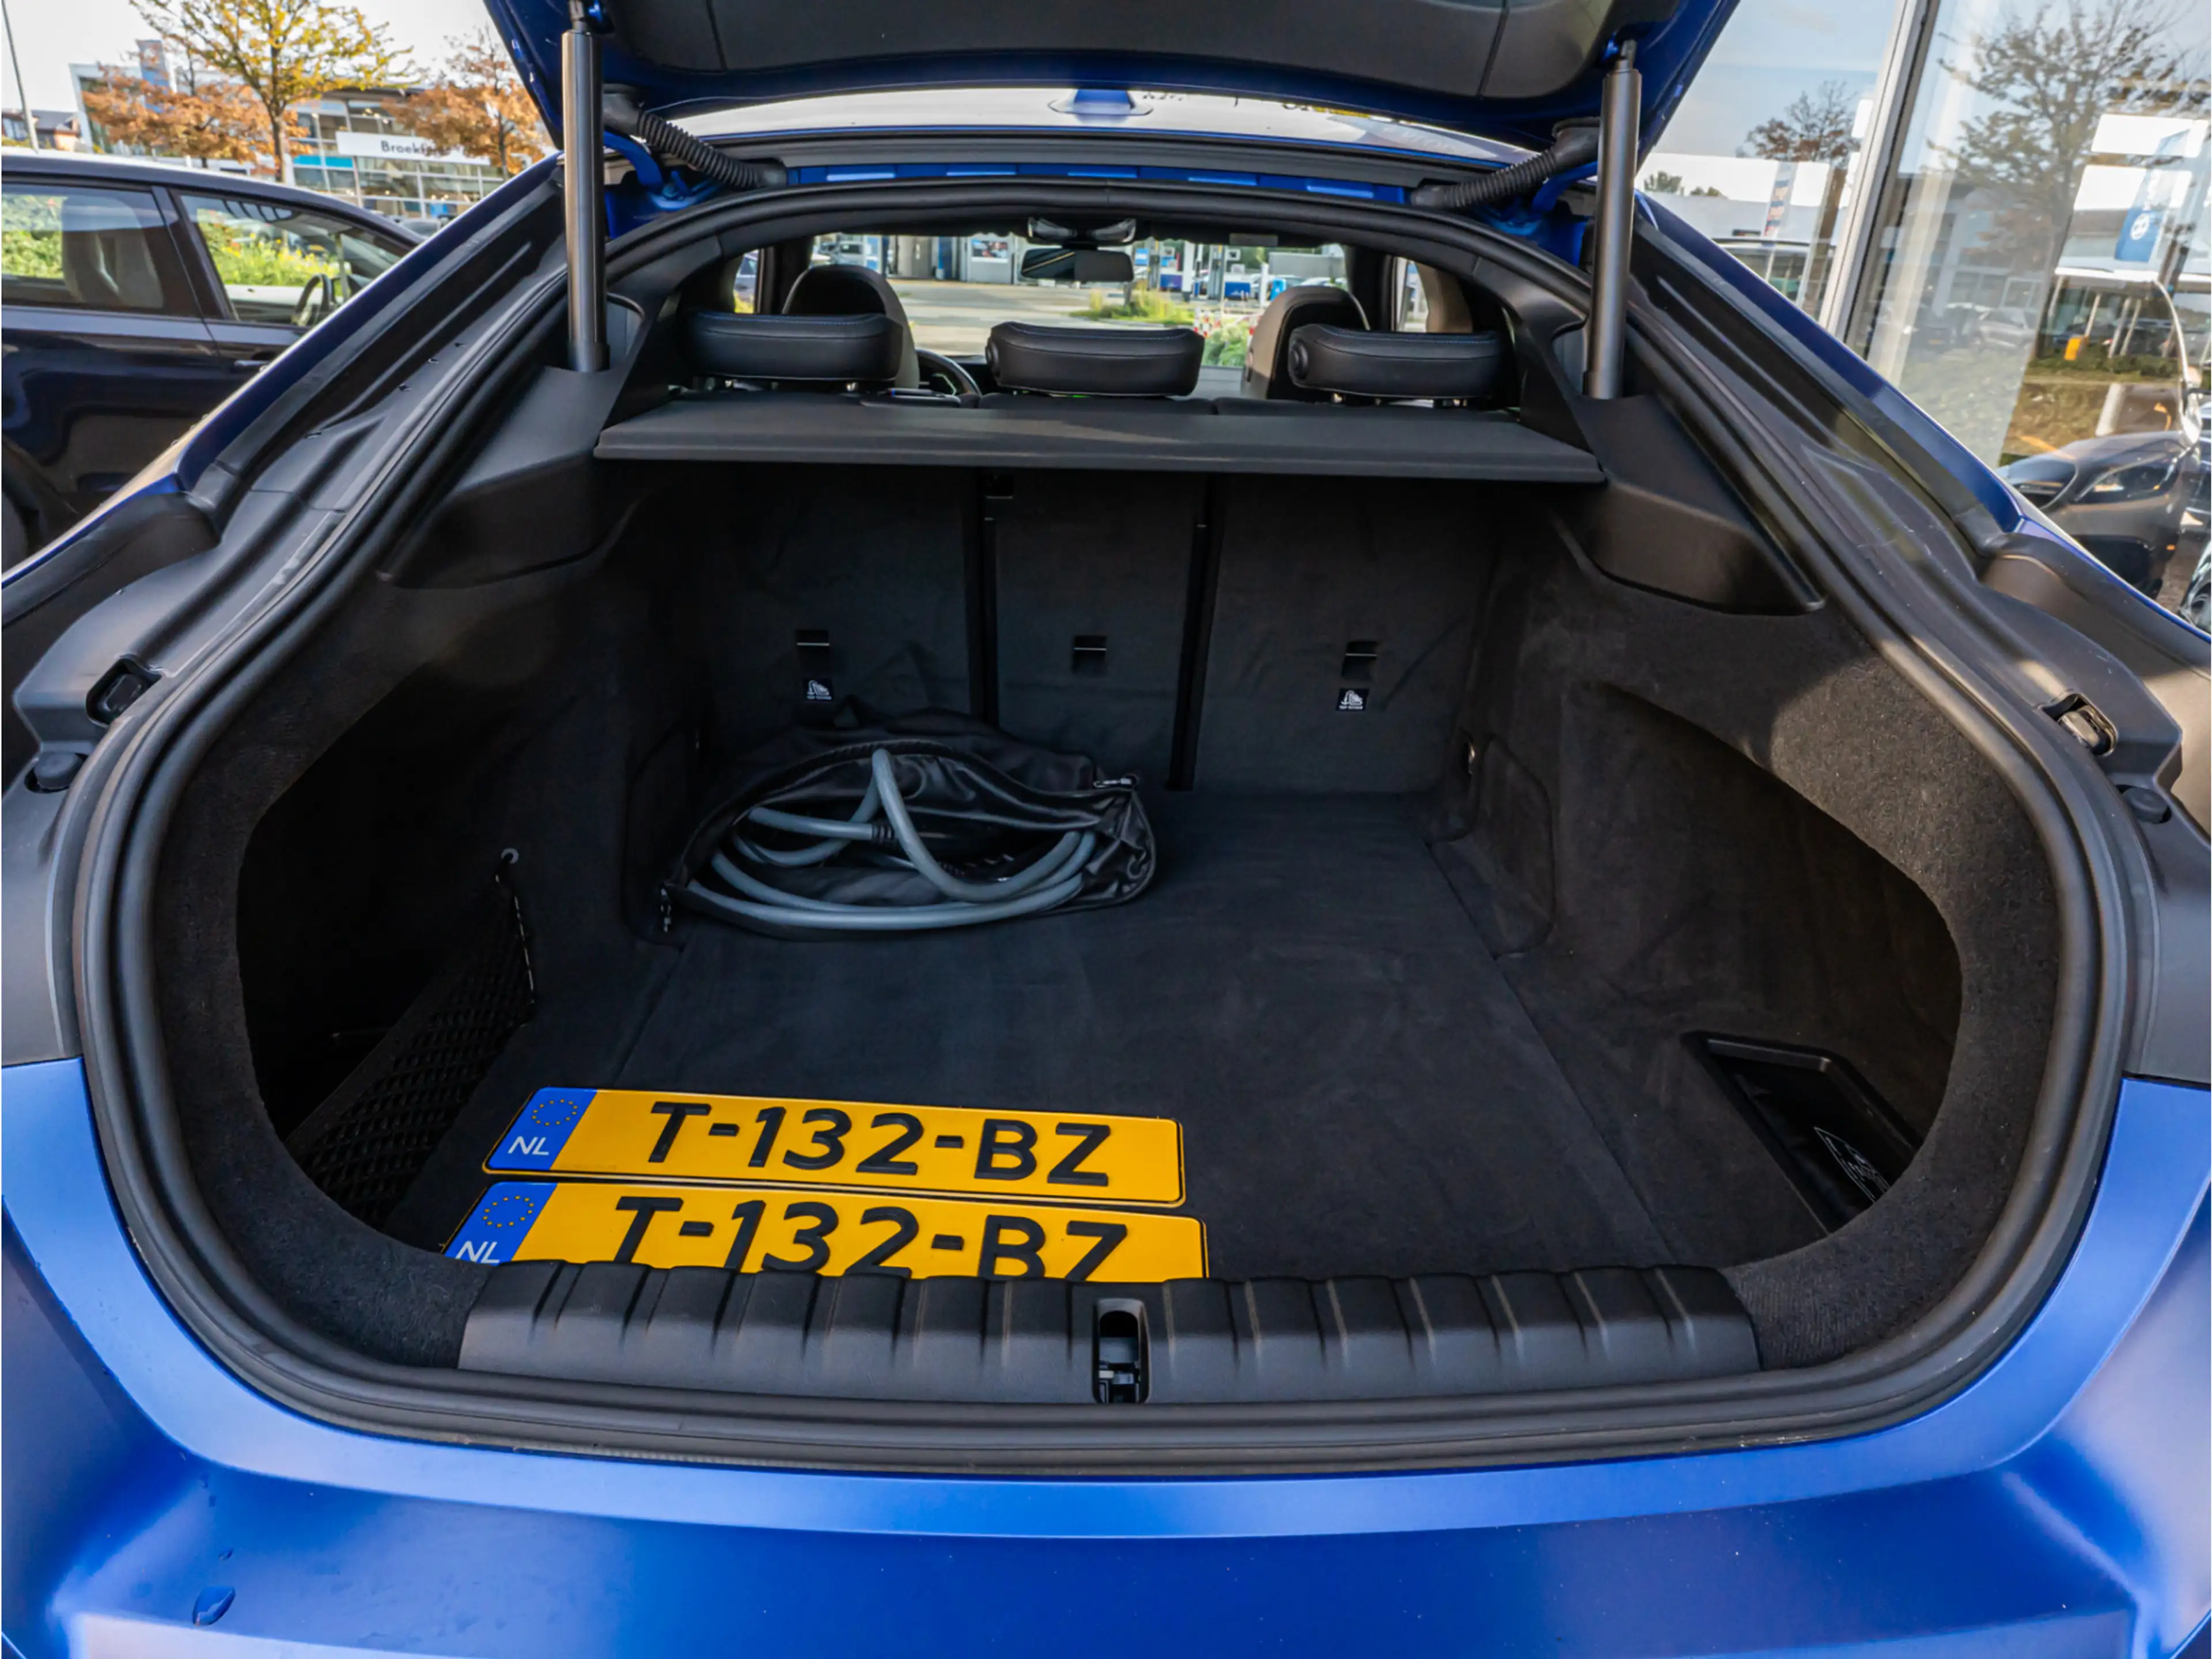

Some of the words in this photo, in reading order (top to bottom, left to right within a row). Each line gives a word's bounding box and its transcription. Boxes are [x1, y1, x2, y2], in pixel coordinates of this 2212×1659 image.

[507, 1136, 549, 1156] NL
[648, 1101, 1111, 1187] T-132-BZ
[455, 1240, 499, 1263] NL
[614, 1196, 1127, 1282] T-132-BZ
